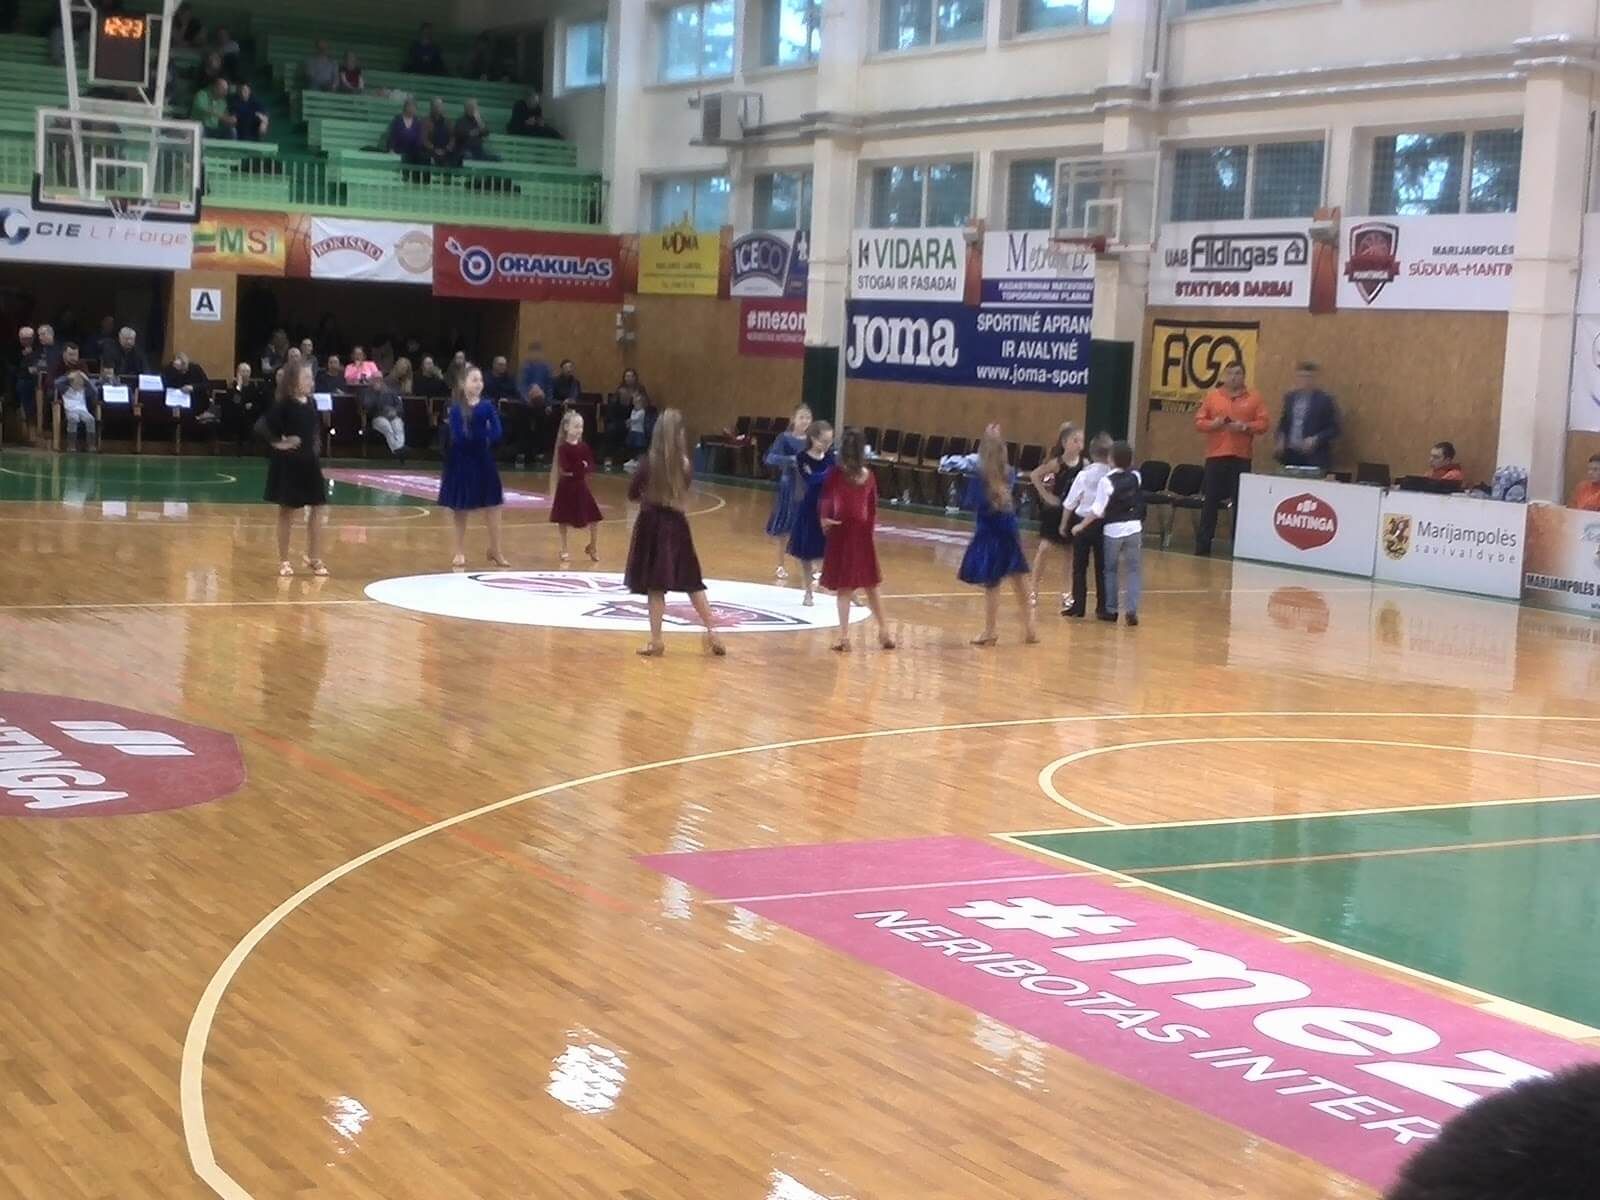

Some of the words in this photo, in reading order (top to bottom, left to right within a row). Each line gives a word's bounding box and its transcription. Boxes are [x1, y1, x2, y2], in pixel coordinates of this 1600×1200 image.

[36, 221, 81, 238] CIE
[499, 254, 611, 279] ORAKULAS
[858, 275, 895, 290] STOGAI
[898, 276, 909, 290] IR
[911, 276, 957, 291] FASADAI
[1175, 281, 1240, 297] STATYBOS
[196, 291, 214, 312] A
[1002, 340, 1015, 358] IR
[1276, 512, 1334, 532] MANTINGA
[855, 909, 1211, 1044] NERIBOTAS
